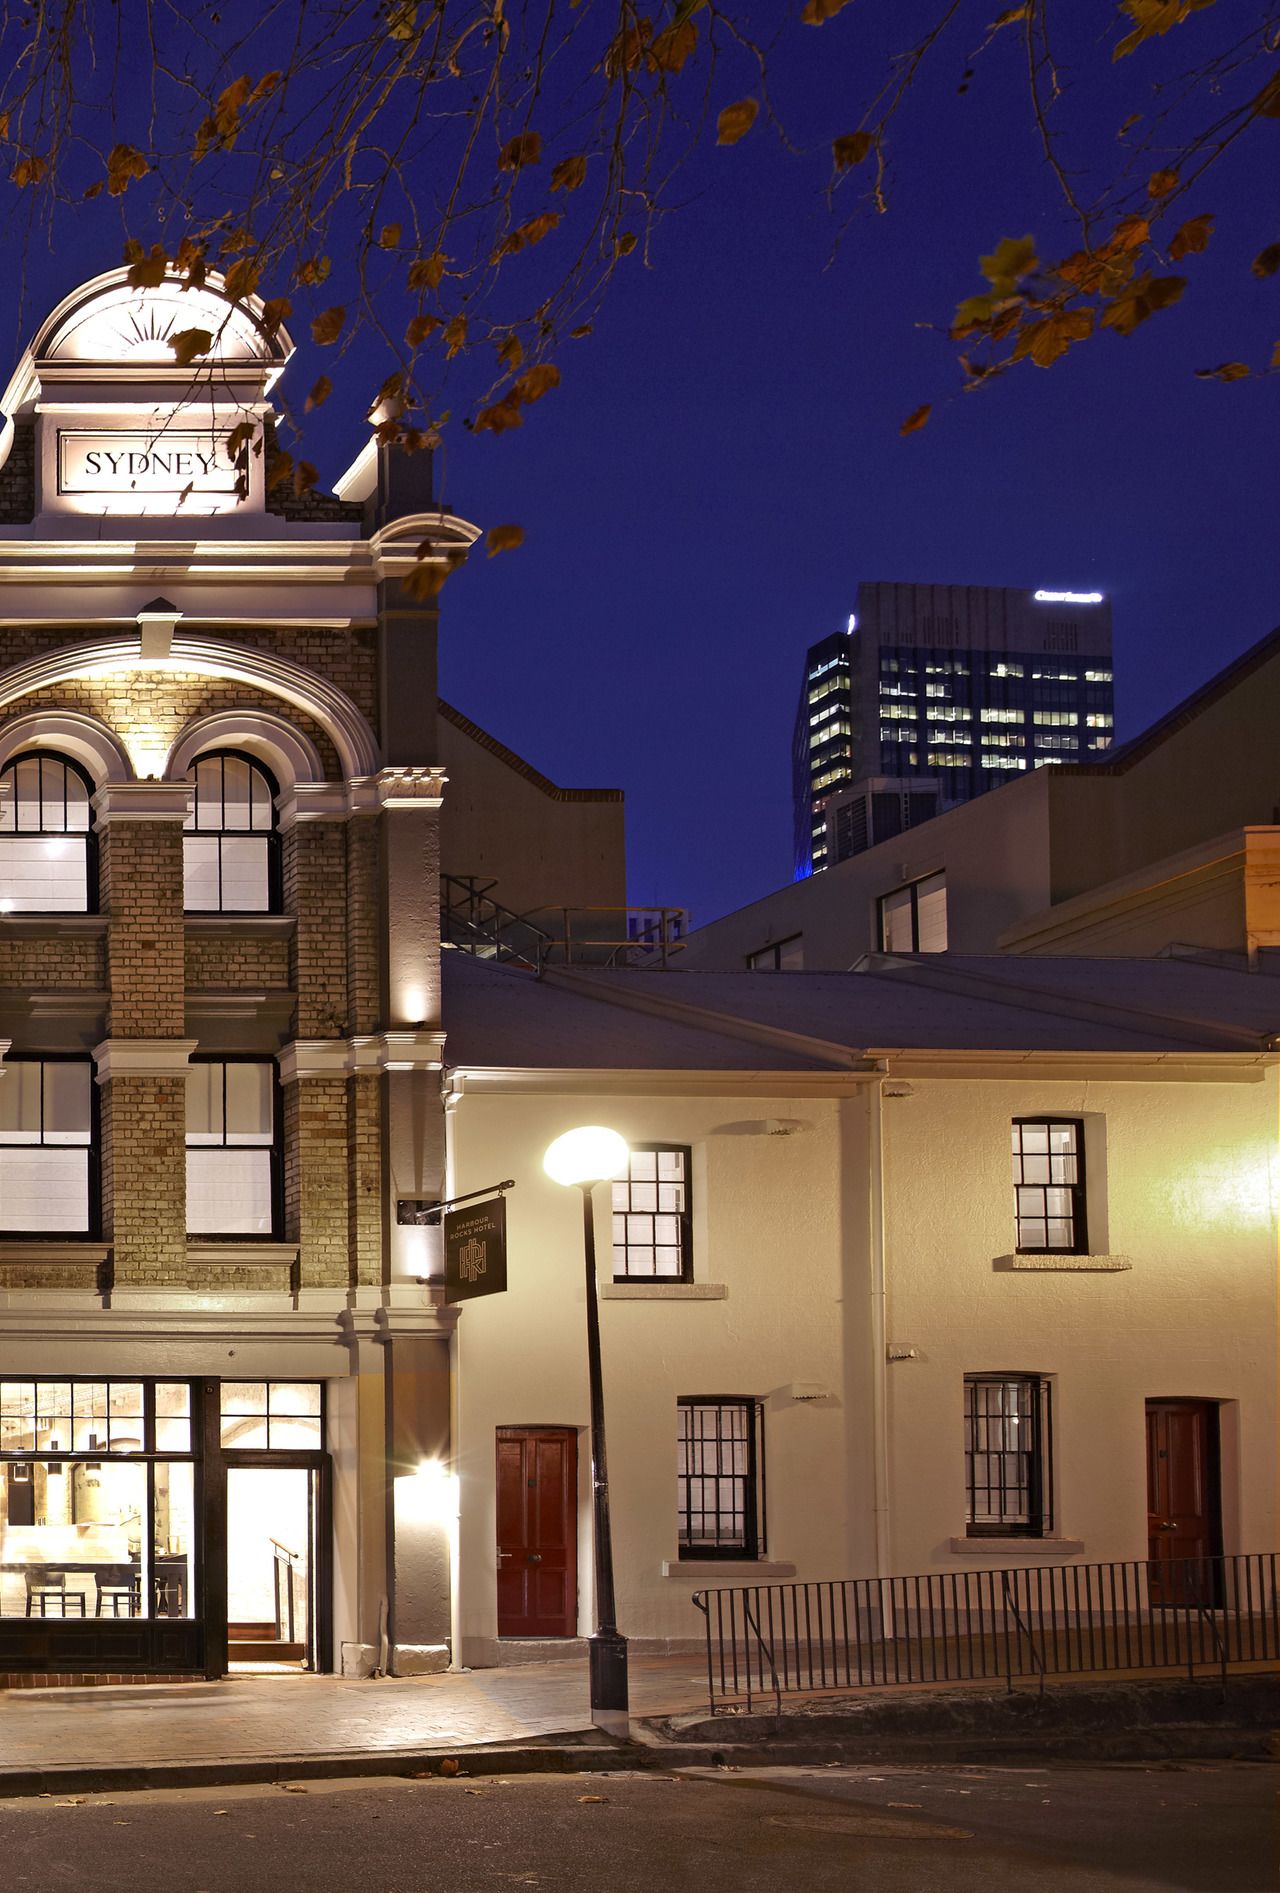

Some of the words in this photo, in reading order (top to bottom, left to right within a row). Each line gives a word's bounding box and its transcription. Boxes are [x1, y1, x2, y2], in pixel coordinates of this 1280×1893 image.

[85, 451, 215, 475] SYDNEY
[449, 1228, 472, 1240] ROCKS
[473, 1222, 497, 1234] HOTEL
[456, 1216, 489, 1231] HARBOUR
